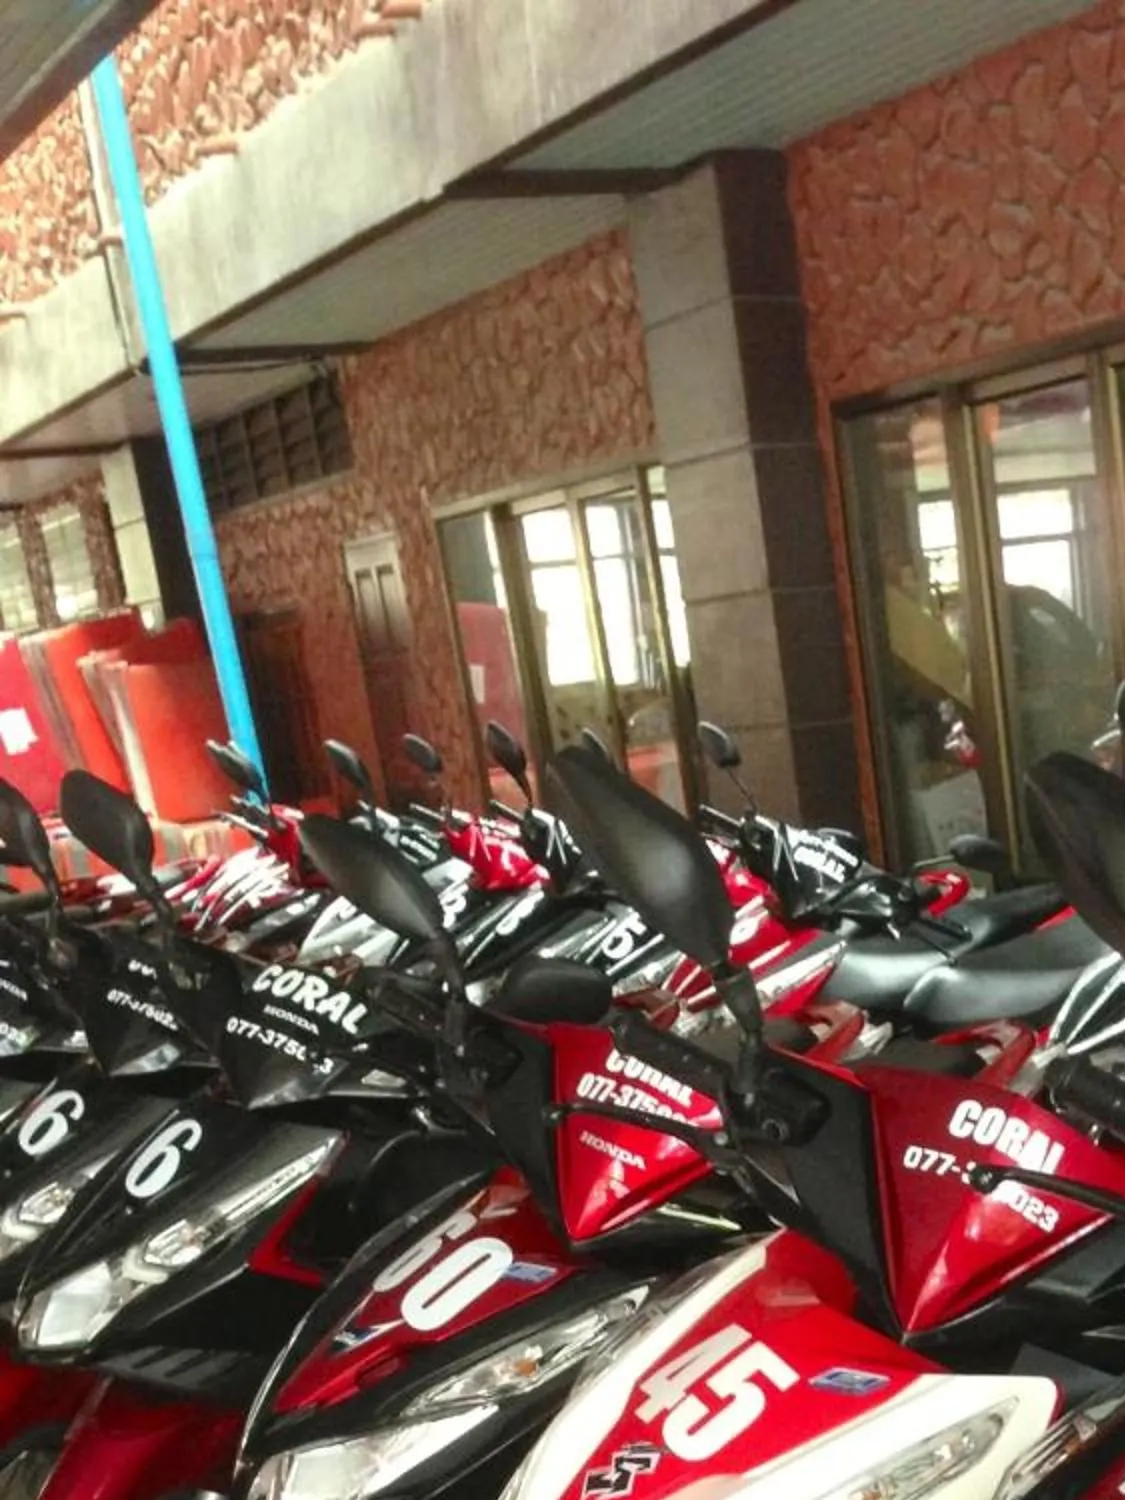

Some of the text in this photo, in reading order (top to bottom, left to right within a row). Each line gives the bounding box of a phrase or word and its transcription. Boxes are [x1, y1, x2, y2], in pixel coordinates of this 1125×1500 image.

[252, 964, 367, 1034] CORAL
[263, 1004, 320, 1036] HONDA
[18, 1089, 85, 1156] 6
[579, 1130, 646, 1171] HONDA
[125, 1119, 202, 1197] 6
[635, 1323, 800, 1461] 45
